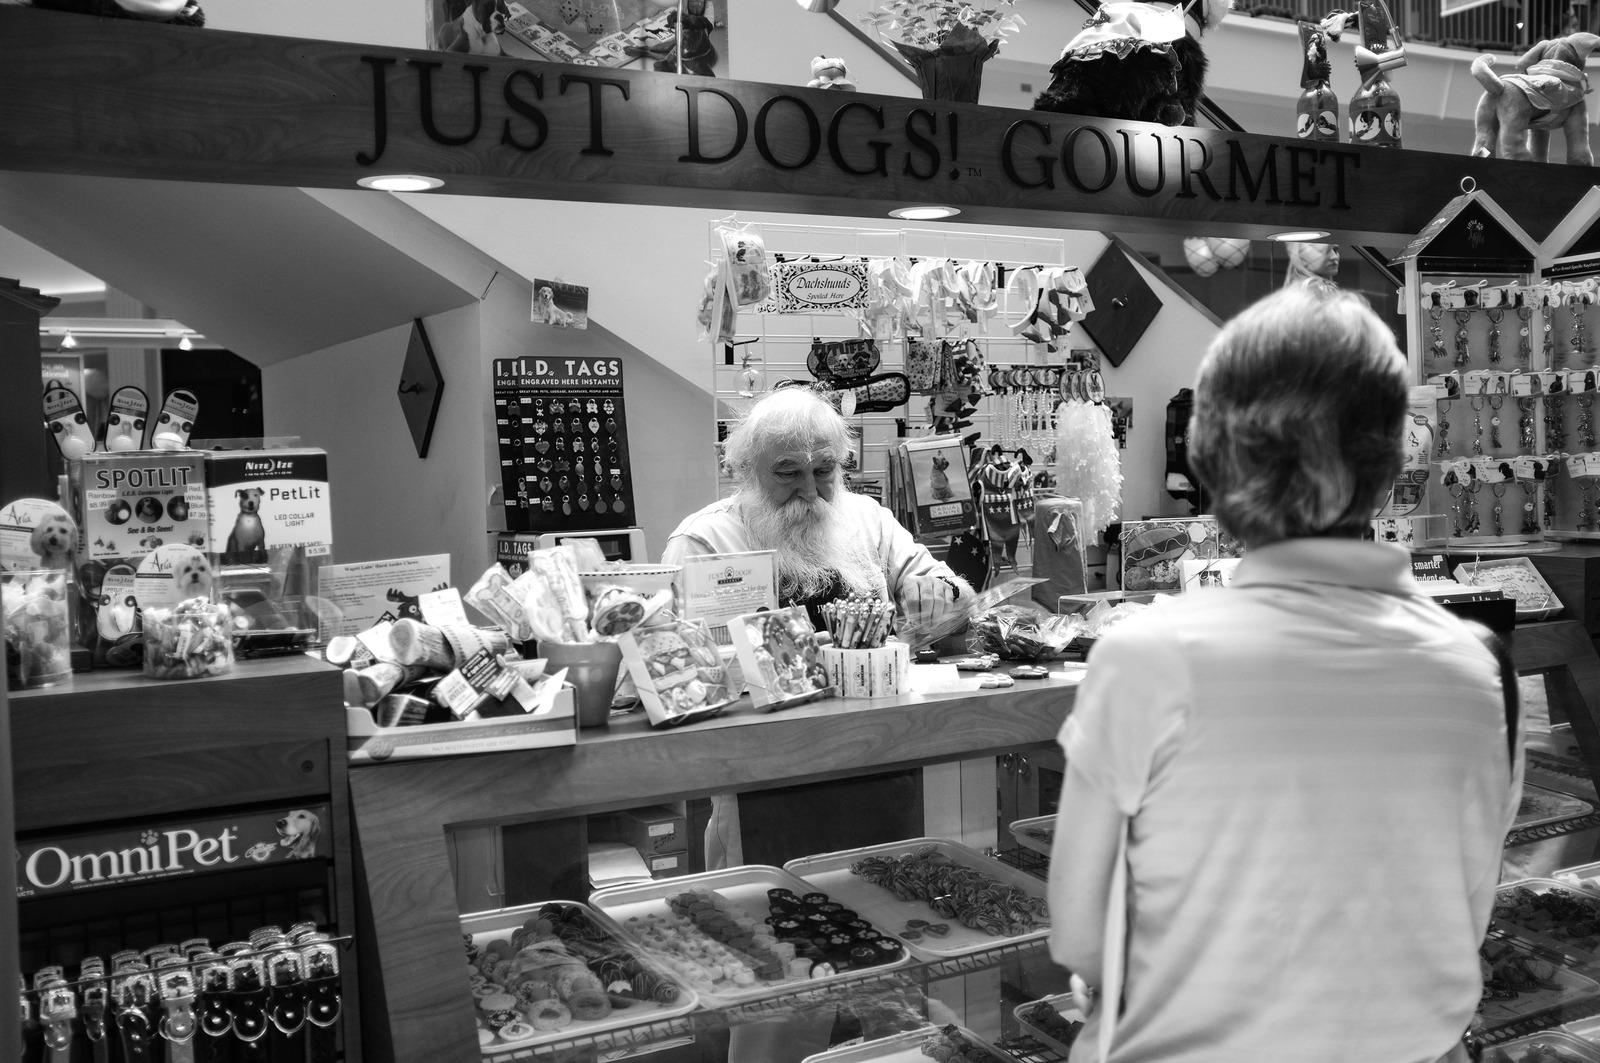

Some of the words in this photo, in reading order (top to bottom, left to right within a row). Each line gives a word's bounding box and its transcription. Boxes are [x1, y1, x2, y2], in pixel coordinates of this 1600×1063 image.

[356, 55, 630, 166] JUST
[675, 85, 960, 180] DOGS!
[1002, 119, 1360, 210] GOURMET
[796, 276, 851, 289] Dachshunds
[807, 292, 829, 300] Spoiled
[565, 360, 619, 376] TAGS
[245, 461, 270, 470] NITE
[276, 460, 294, 468] IZE
[96, 467, 191, 489] SPOTLIT
[270, 486, 321, 501] PetLit
[931, 504, 961, 512] CASUAL
[932, 509, 962, 517] CANINE
[140, 526, 146, 534] &
[157, 525, 174, 533] Seen!
[513, 542, 532, 554] TAGS
[1414, 560, 1441, 570] smarter
[709, 572, 724, 581] JUST
[26, 828, 239, 888] OmniPet
